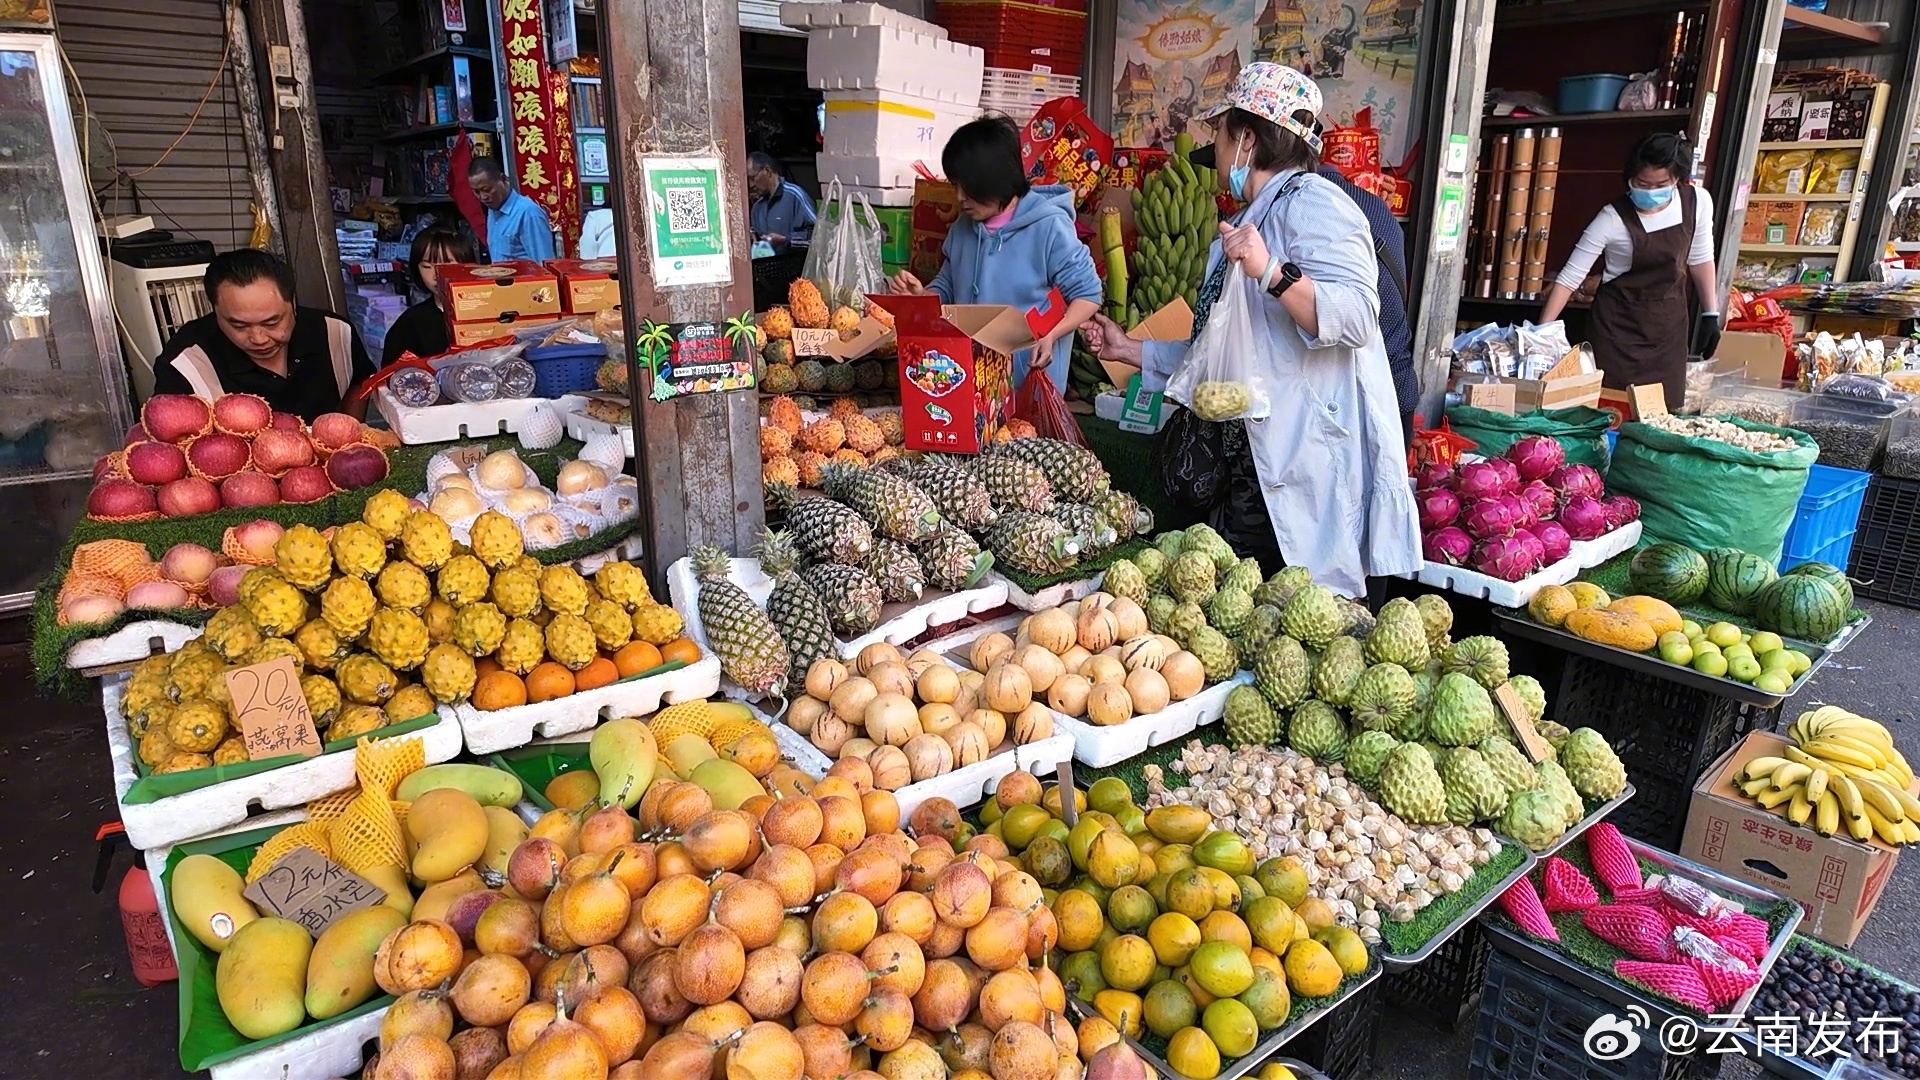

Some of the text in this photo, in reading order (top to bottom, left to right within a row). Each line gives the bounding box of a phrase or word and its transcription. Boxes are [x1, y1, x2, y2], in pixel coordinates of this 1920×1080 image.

[1053, 137, 1098, 191] 精品名果
[796, 329, 835, 342] 10元/个
[798, 341, 829, 355] 海参
[232, 668, 307, 721] 20元/斤
[248, 723, 317, 756] 燕窝果
[1713, 821, 1723, 832] 5
[1711, 833, 1720, 844] 4
[1742, 818, 1814, 853] 绿色生态
[1708, 846, 1718, 858] 3
[1827, 862, 1841, 873] 10
[259, 860, 346, 916] 12元/斤
[1770, 879, 1791, 890] KEEP
